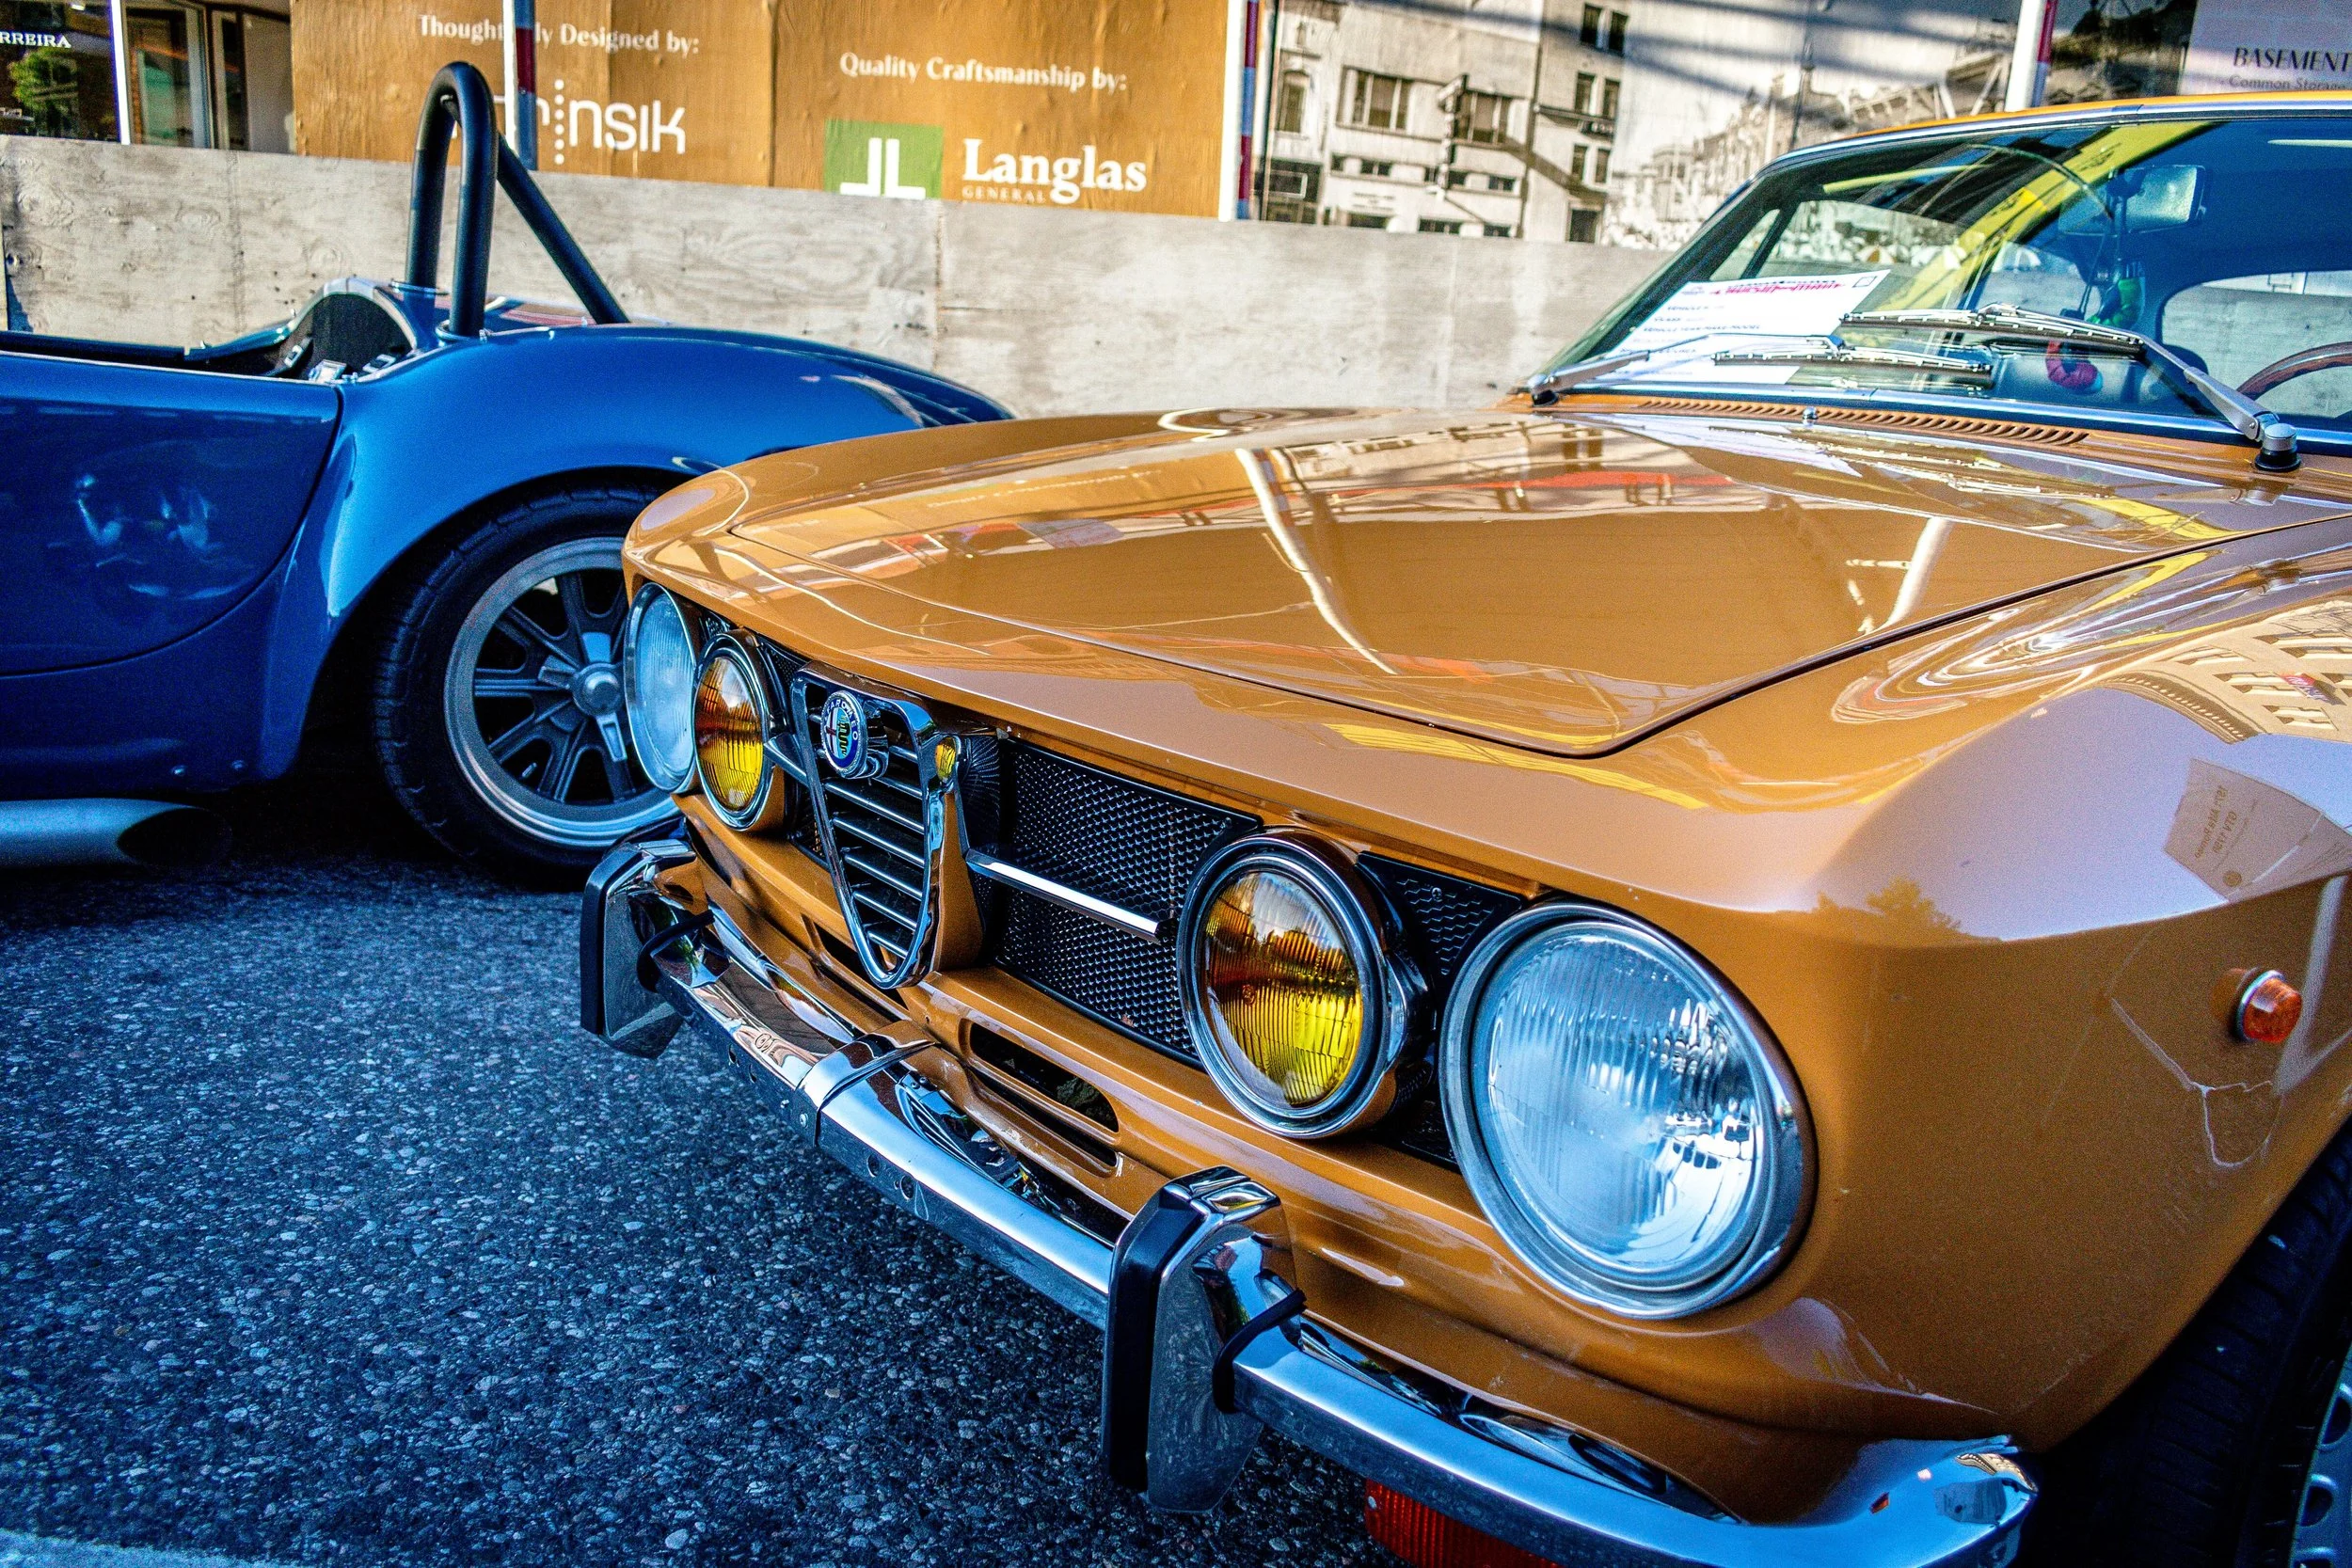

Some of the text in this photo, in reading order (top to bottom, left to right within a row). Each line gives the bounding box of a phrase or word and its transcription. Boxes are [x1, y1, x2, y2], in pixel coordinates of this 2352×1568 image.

[420, 14, 699, 59] Thoughtly Designed by:
[840, 52, 1127, 94] Quality Craftsmanship by:
[2233, 46, 2352, 71] BASEMENT
[2229, 75, 2291, 89] Common
[961, 137, 1148, 205] Langlas
[961, 184, 1047, 204] GENERAL
